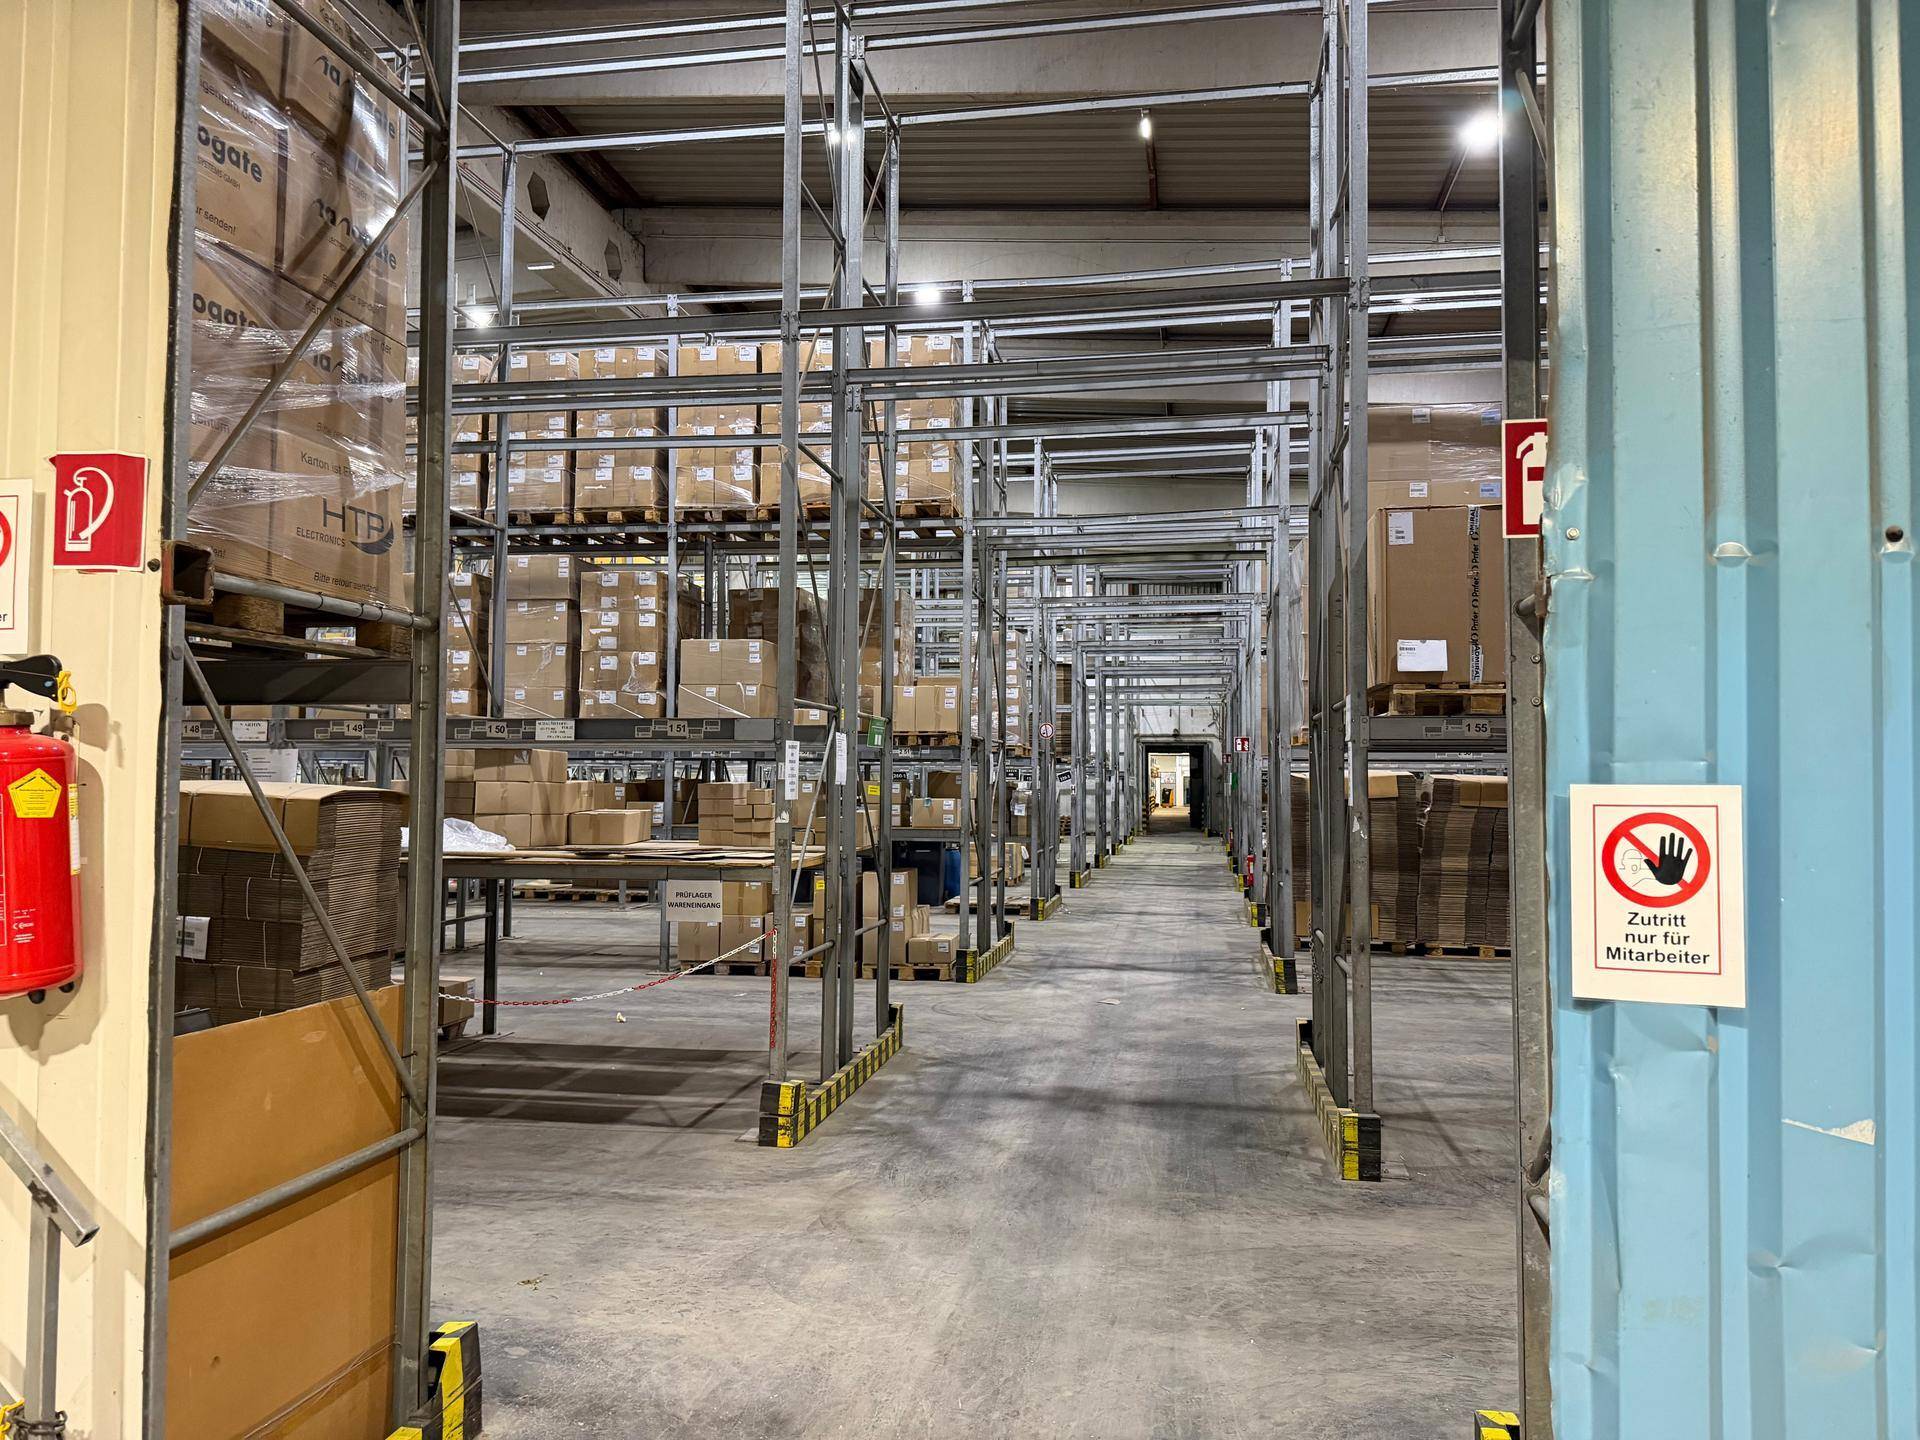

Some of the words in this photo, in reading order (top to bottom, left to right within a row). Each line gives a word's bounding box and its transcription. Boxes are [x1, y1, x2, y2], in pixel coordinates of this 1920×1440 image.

[193, 293, 258, 329] ogat
[300, 451, 330, 471] Karton
[322, 497, 385, 539] HTP
[296, 526, 346, 548] ELECTRONICS
[494, 725, 506, 734] 50
[676, 724, 686, 733] 51
[1474, 723, 1488, 733] 55
[675, 890, 713, 899] PRÜFLAGER
[668, 901, 721, 909] WARENEINGANG
[1627, 911, 1687, 928] Zutritt
[1625, 932, 1658, 945] nur
[1663, 931, 1691, 946] für
[1605, 946, 1711, 964] Mitarbeiter
